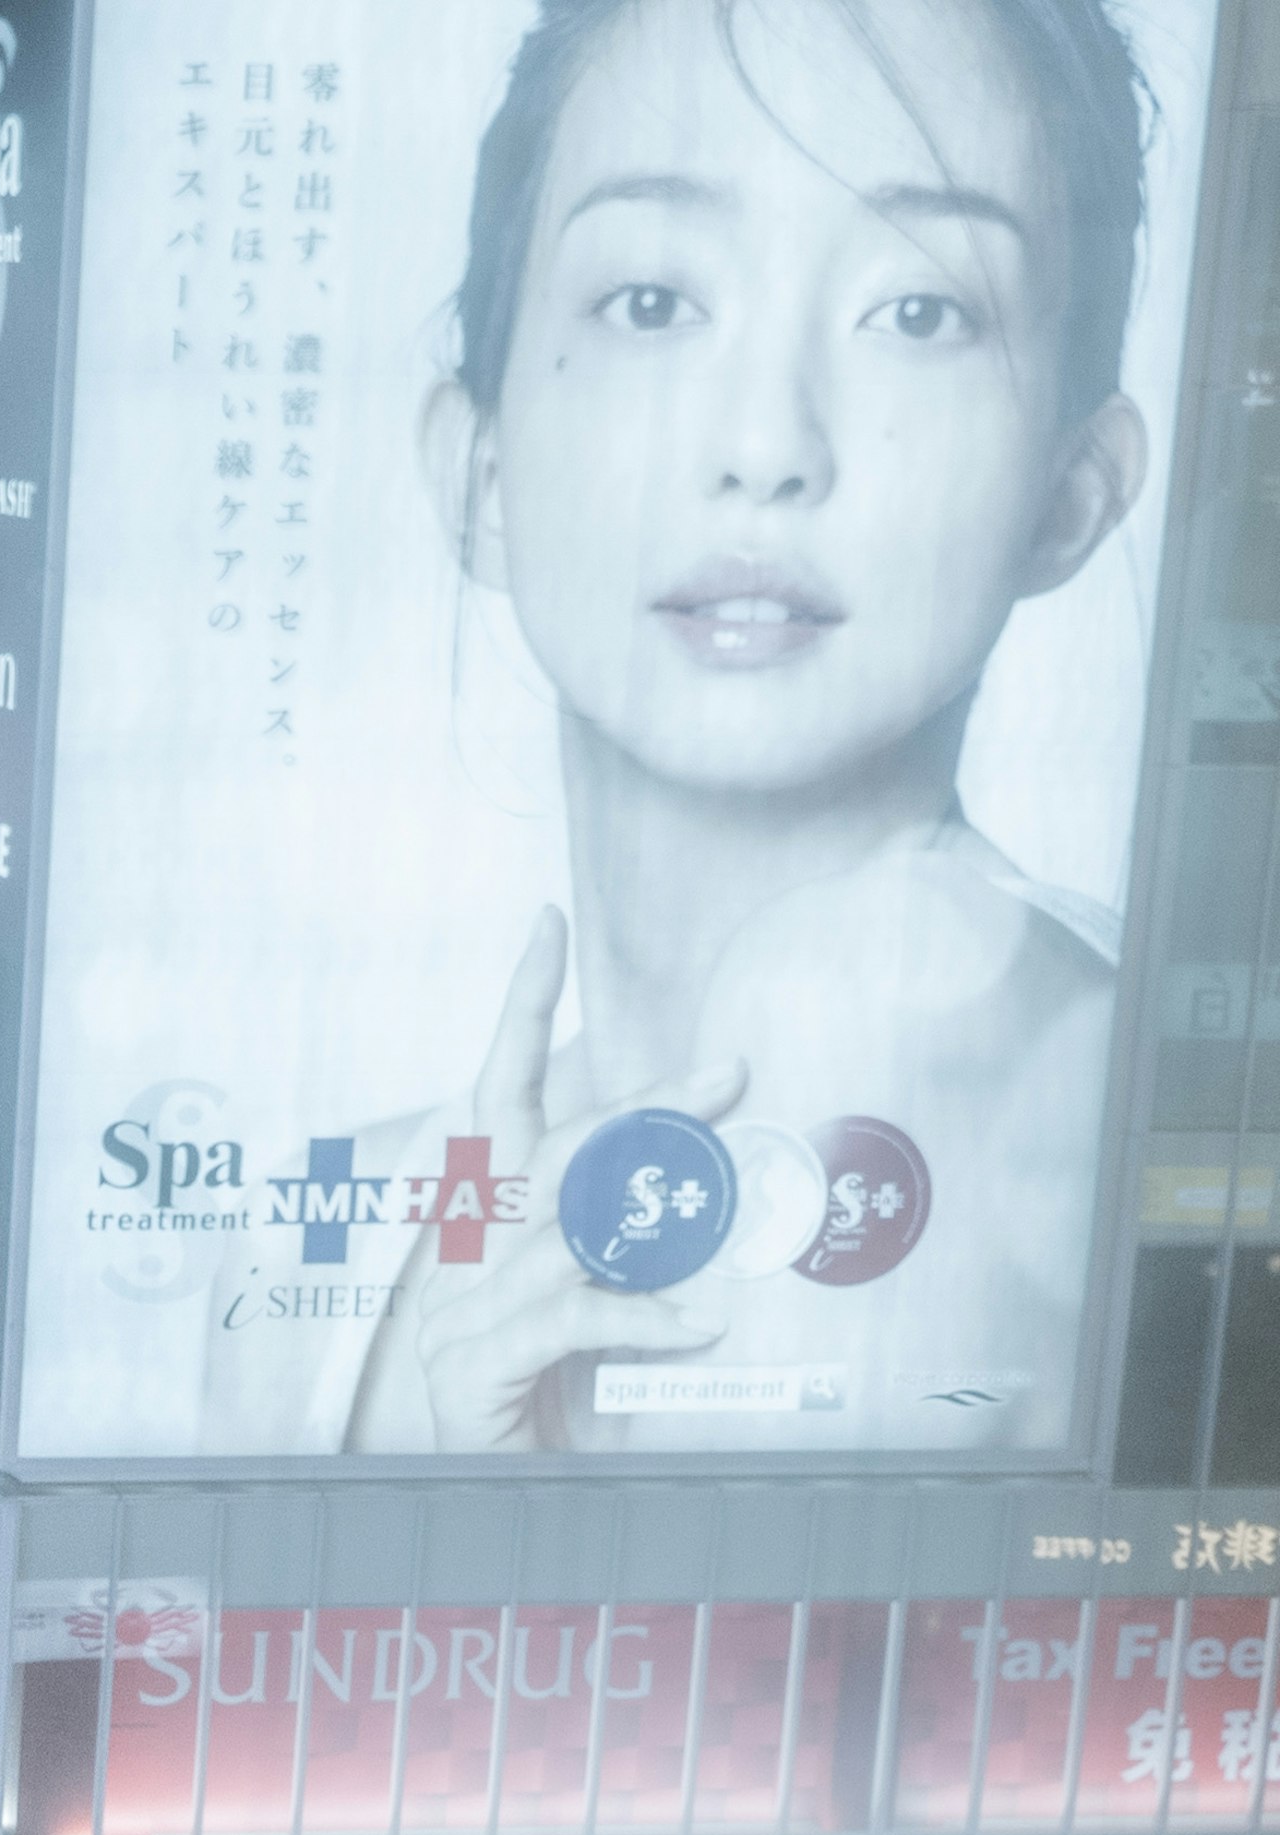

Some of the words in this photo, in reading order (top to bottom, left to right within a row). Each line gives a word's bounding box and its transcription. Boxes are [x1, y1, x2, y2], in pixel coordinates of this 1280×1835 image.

[166, 61, 213, 364] エキスパート
[207, 62, 275, 633] 目元とほうれい線ケアの
[98, 1119, 245, 1208] Spa
[87, 1208, 251, 1231] treatment
[266, 1285, 406, 1318] SHEET
[139, 1625, 655, 1708] SUNDRUG
[960, 1626, 1085, 1683] Tax
[1114, 1624, 1268, 1681] Free
